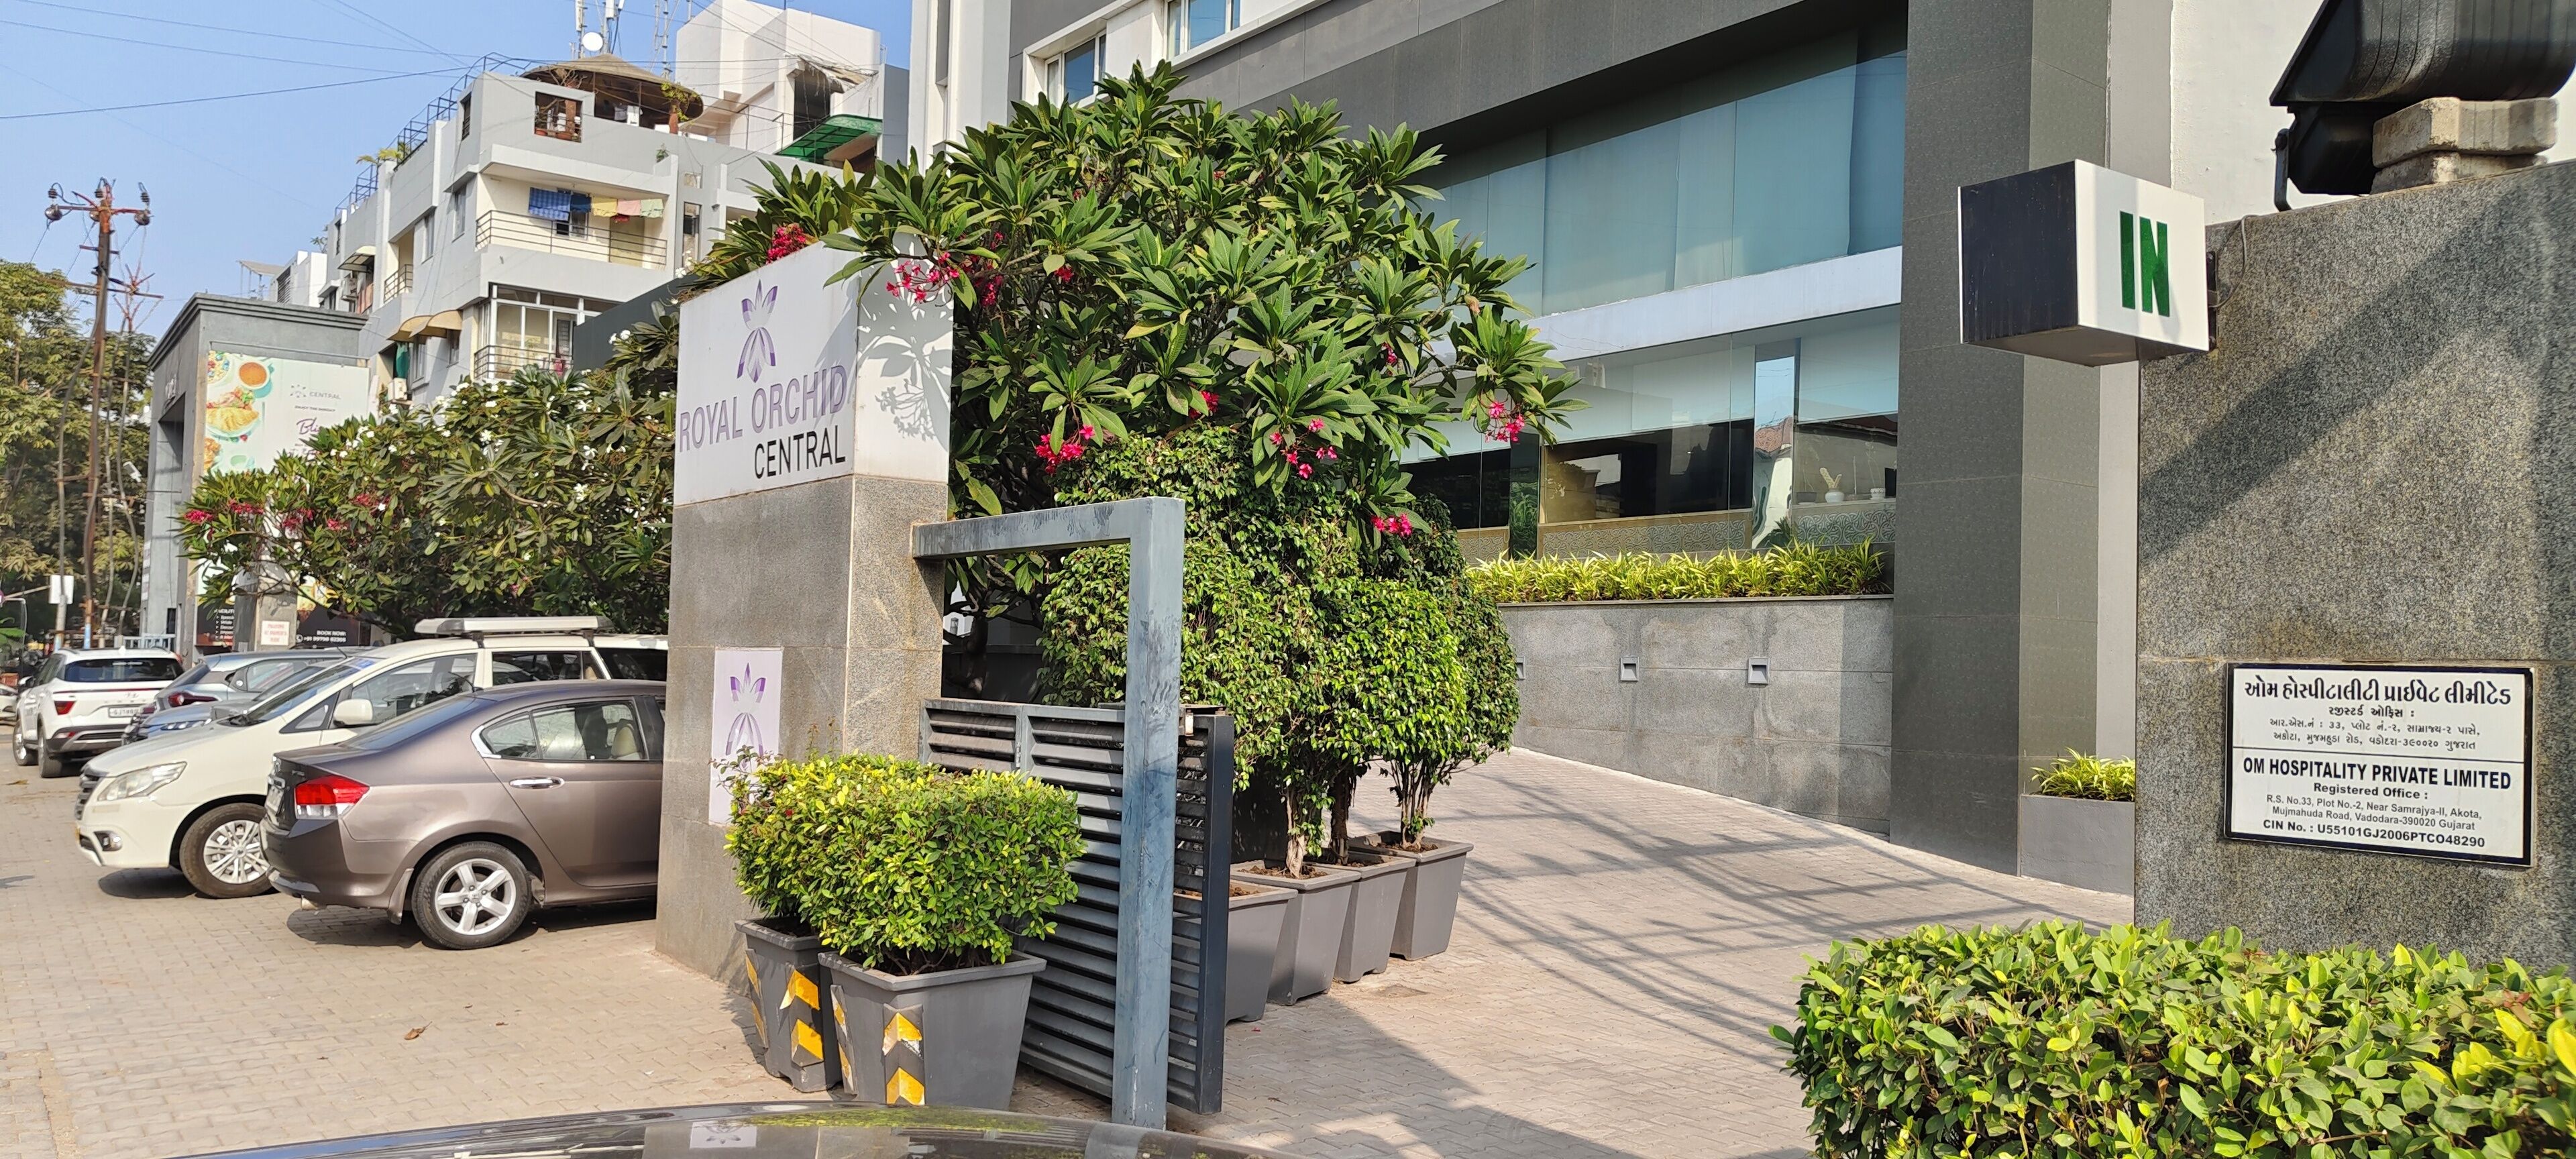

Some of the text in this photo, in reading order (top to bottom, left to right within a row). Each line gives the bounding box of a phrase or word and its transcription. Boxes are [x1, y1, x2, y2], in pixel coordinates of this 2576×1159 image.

[2119, 211, 2170, 317] IN
[680, 365, 847, 452] ROYAL ORCHID
[754, 425, 846, 480] CENTRAL
[2245, 675, 2511, 704] ઓમ હોસ્પીટાલીટી પ્રાઈવેટ લીમીટેડ
[2371, 705, 2403, 718] ઓફિસ
[2351, 720, 2371, 731] પ્લોટ
[2273, 729, 2301, 742] અકોટા,
[2346, 732, 2363, 745] રોડ,
[2445, 740, 2475, 751] ગુજરાત
[2243, 757, 2511, 789] OM HOSPITALITY PRIVATE LIMITED
[2314, 783, 2378, 796] Registered
[2383, 787, 2420, 799] Office
[2267, 794, 2482, 820] R.S. No.33, Plot No.-2, Near Samrajya-II, Akota,
[2272, 806, 2475, 831] Mujmahuda Road, Vadodara-390020 Gujarat
[2263, 820, 2284, 830] CIN
[2288, 822, 2306, 832] No.
